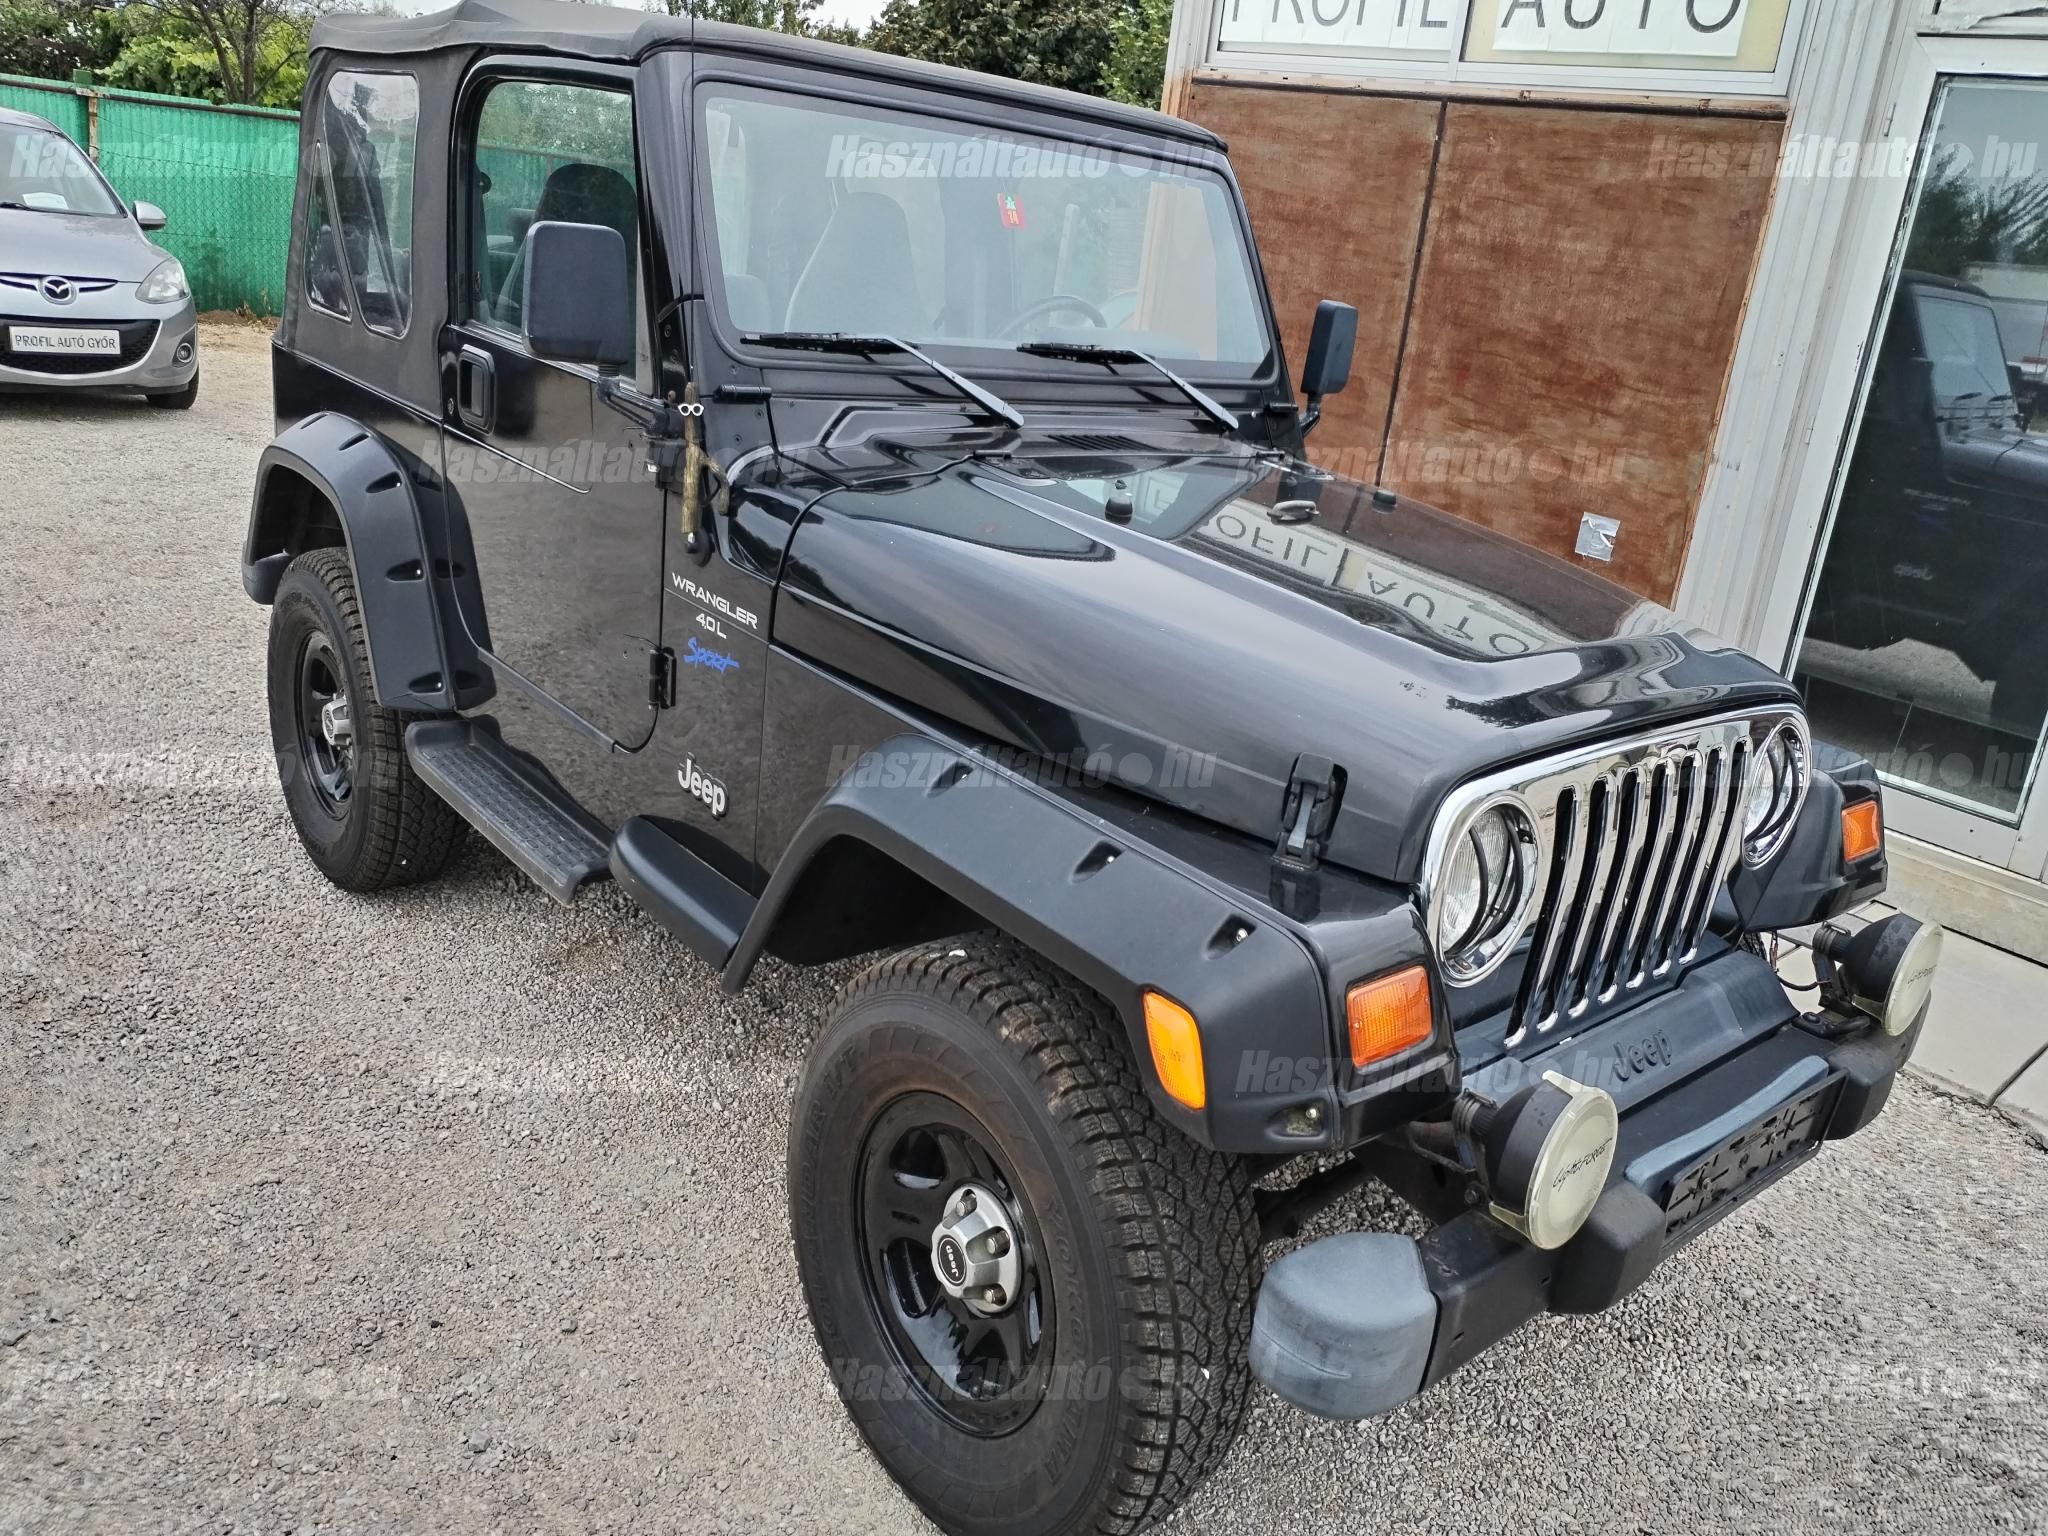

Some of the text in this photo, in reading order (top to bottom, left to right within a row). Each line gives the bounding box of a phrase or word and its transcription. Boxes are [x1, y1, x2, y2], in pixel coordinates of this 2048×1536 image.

[15, 334, 116, 349] PROFIL AUTÓ GYŐR
[672, 572, 758, 630] WRANGLER
[678, 757, 726, 816] Jeep
[1612, 1029, 1673, 1082] Jeep
[945, 1244, 959, 1277] Jeep
